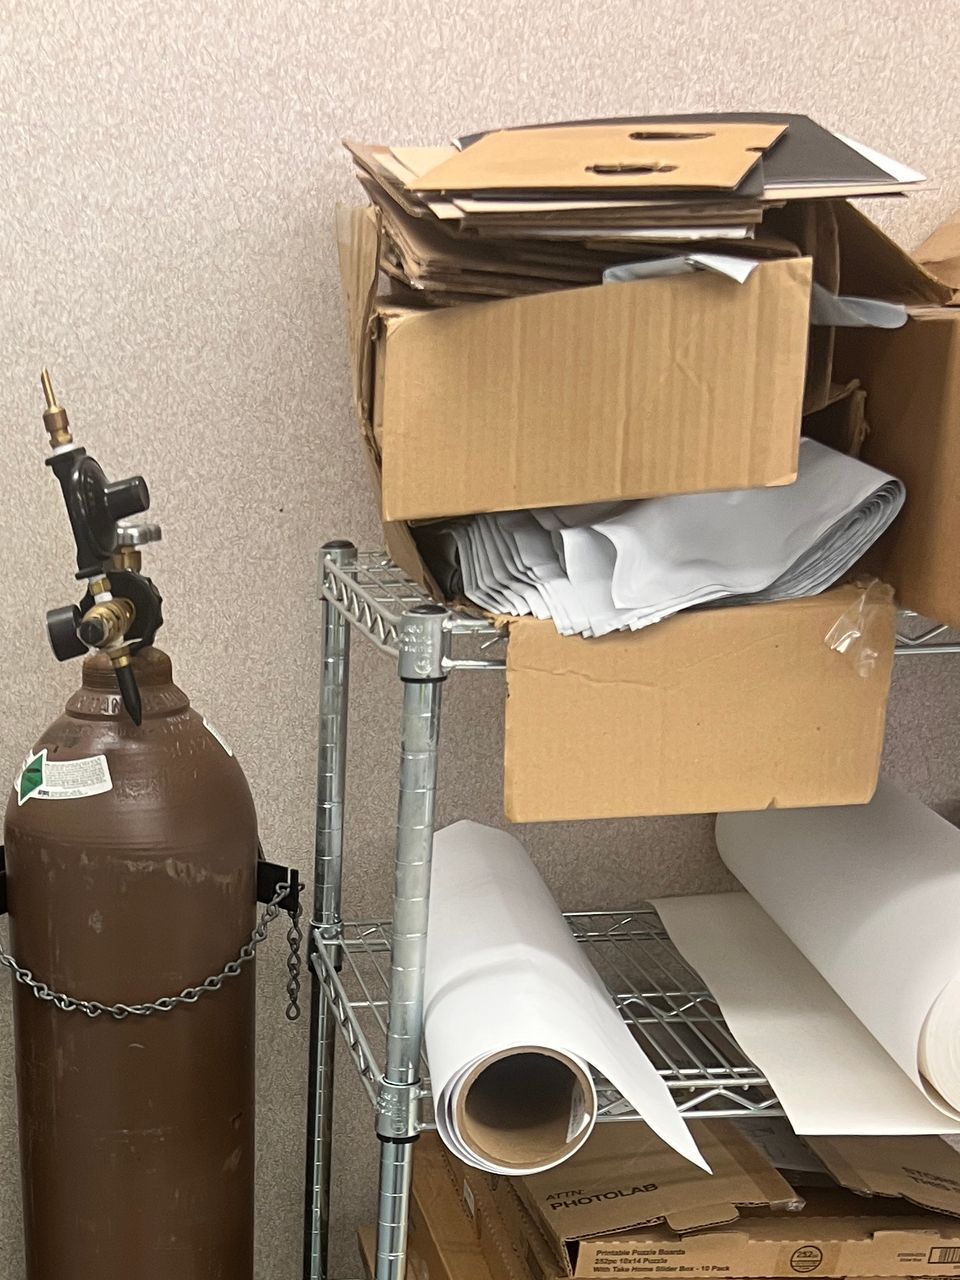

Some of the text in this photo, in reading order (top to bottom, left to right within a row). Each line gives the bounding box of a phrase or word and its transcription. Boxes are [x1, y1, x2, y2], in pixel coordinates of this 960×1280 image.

[550, 1183, 659, 1211] PHOTOLAB
[642, 1256, 668, 1265] Puzzle
[631, 1265, 654, 1273] Home
